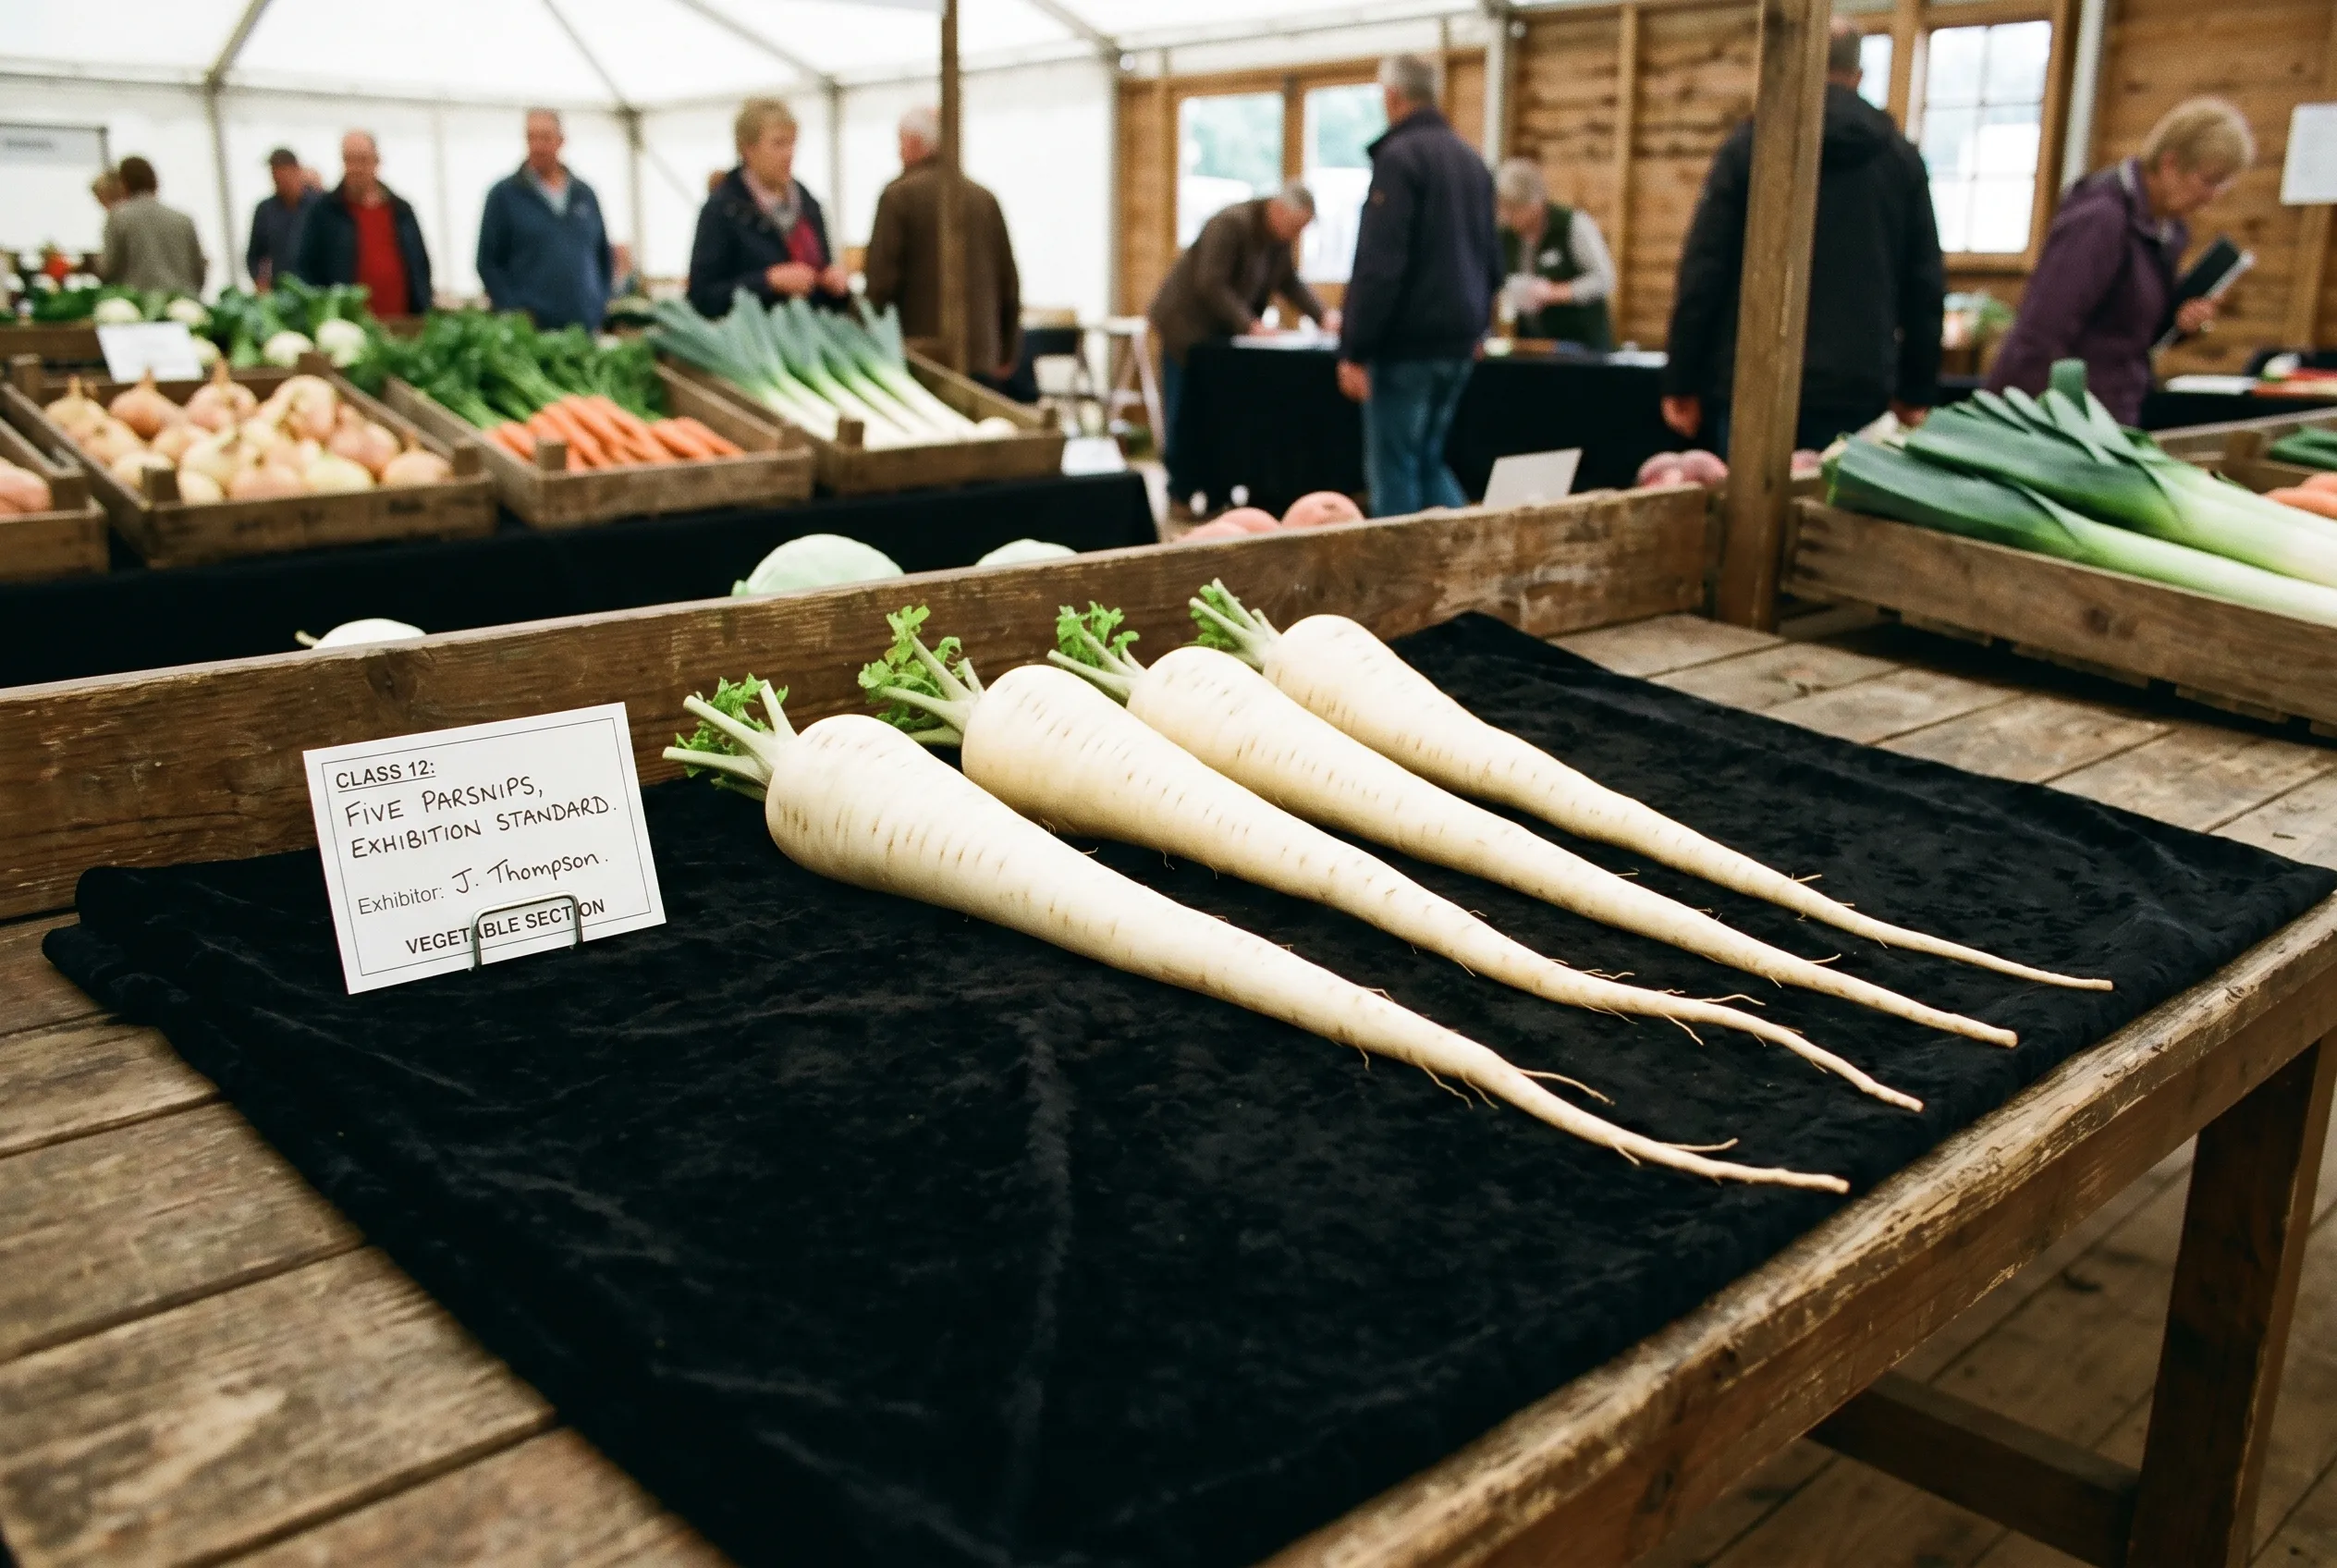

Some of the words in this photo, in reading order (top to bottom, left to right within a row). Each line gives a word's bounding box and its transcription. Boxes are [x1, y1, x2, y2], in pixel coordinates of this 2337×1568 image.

[336, 764, 402, 789] CLASS
[408, 760, 435, 778] 12:
[422, 776, 543, 813] PARSNIPS,
[351, 819, 482, 859] EXHIBITION
[496, 795, 617, 830] STANDARD.
[358, 887, 444, 914] Exhibitor:
[451, 868, 479, 894] J.
[486, 852, 608, 883] Thompson.
[525, 899, 606, 928] SECTON
